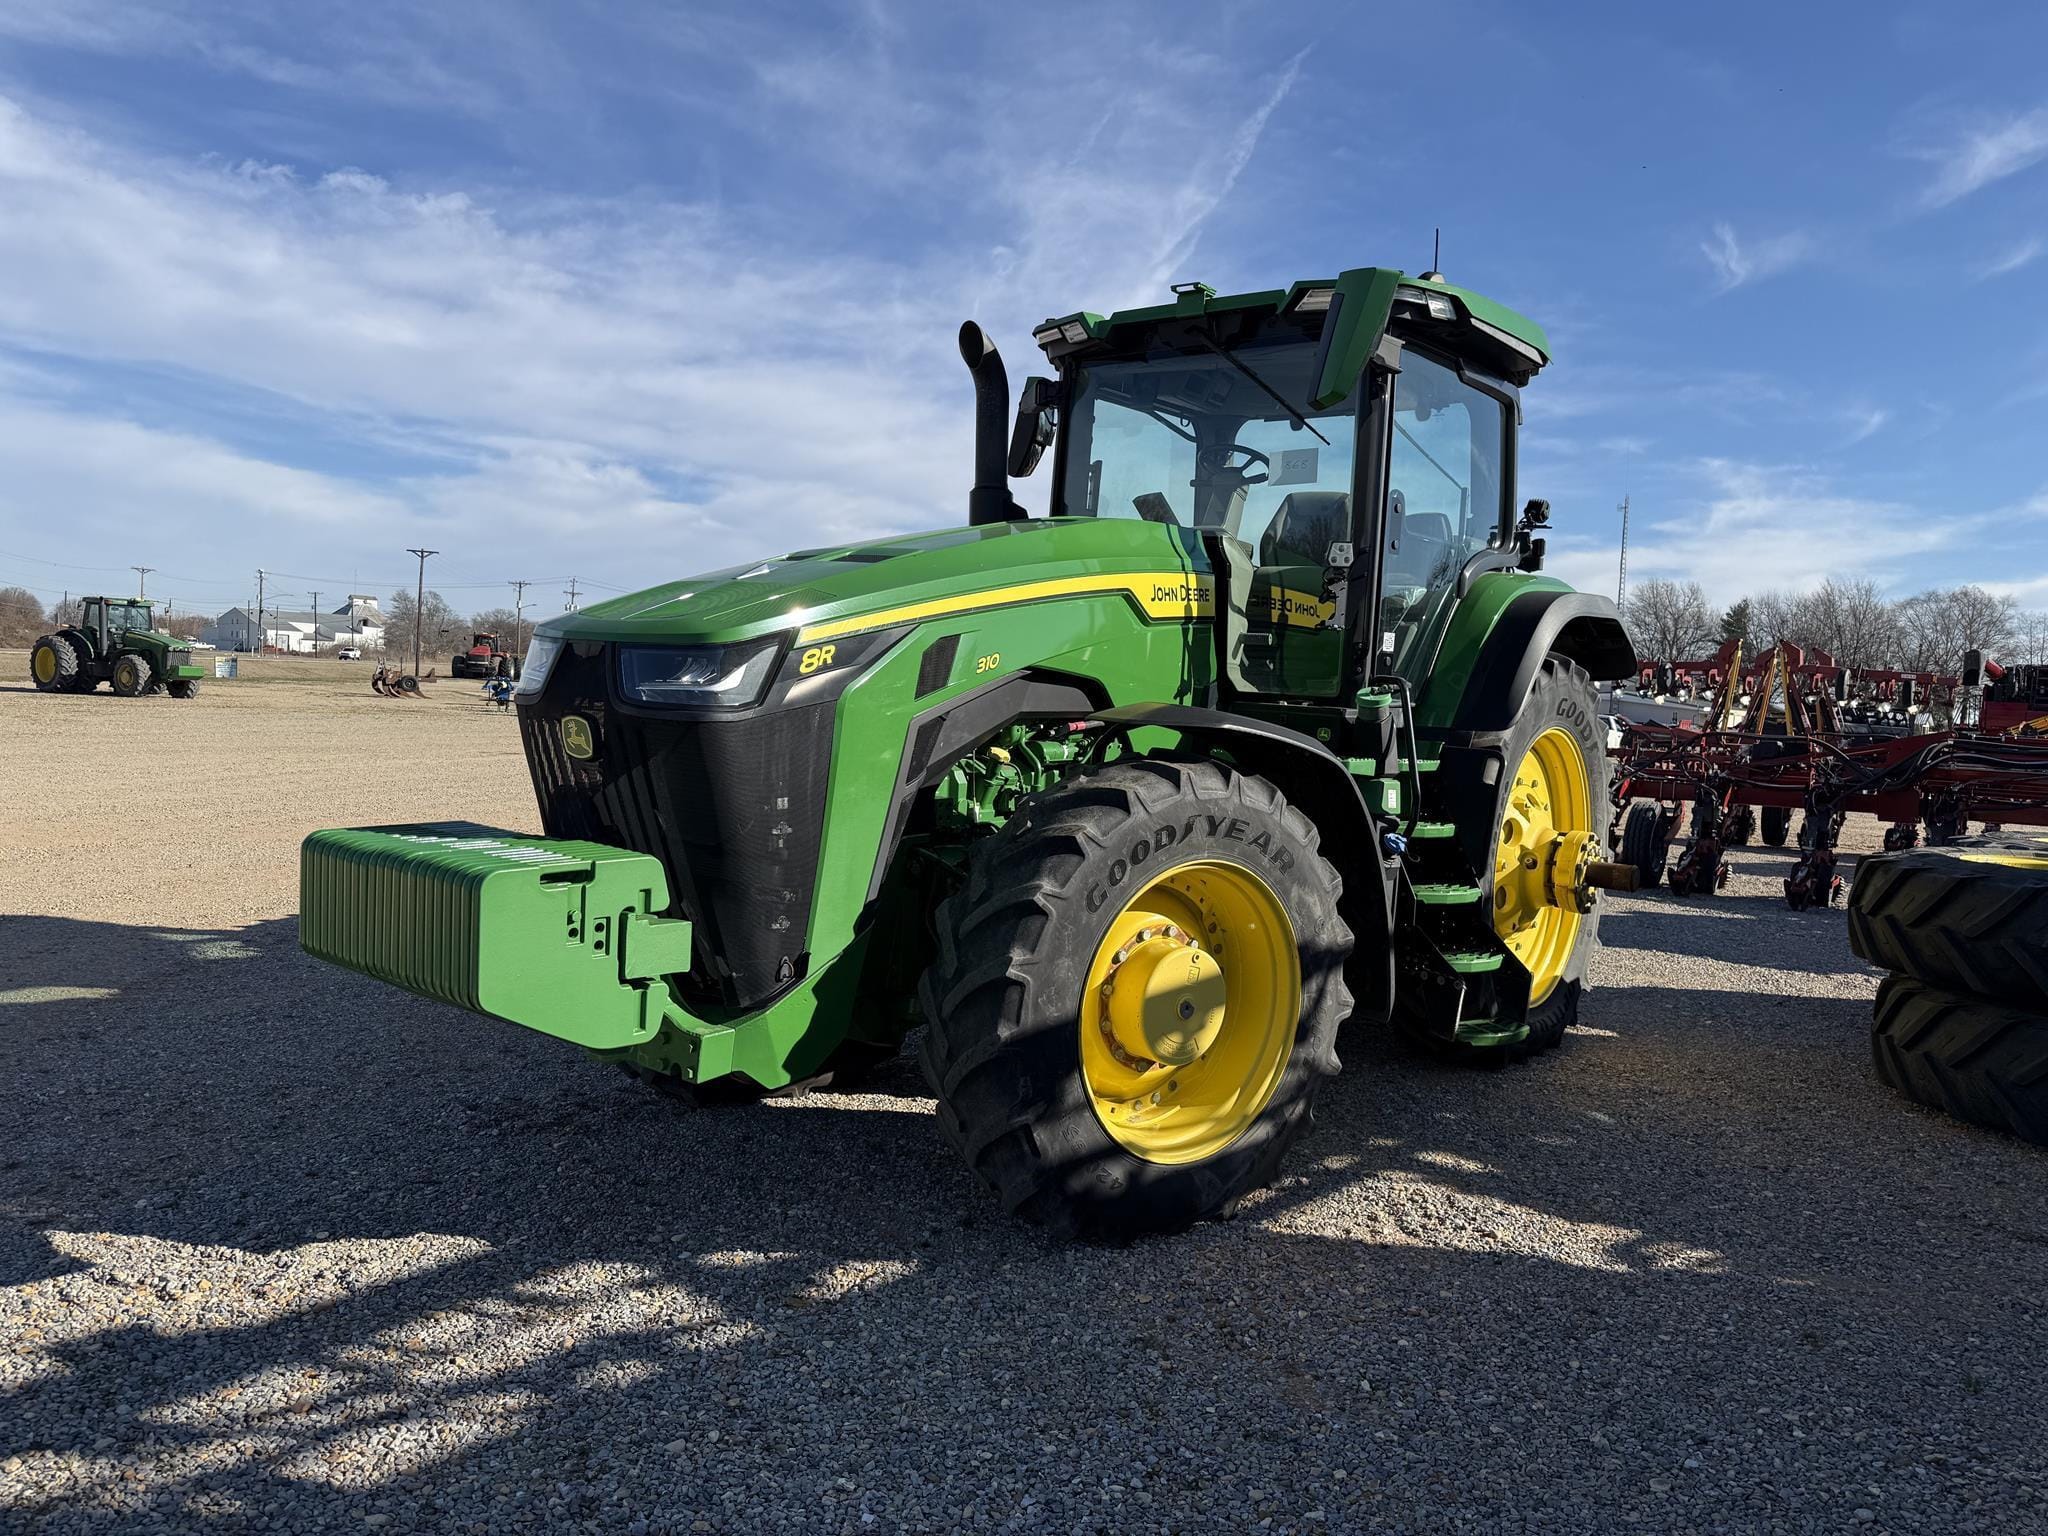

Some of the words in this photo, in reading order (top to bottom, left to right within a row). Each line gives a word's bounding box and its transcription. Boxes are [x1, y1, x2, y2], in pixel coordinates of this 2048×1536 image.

[1151, 584, 1178, 602] JOHN
[1180, 585, 1210, 602] DEERE
[800, 645, 836, 674] 8R
[976, 653, 1001, 674] 310
